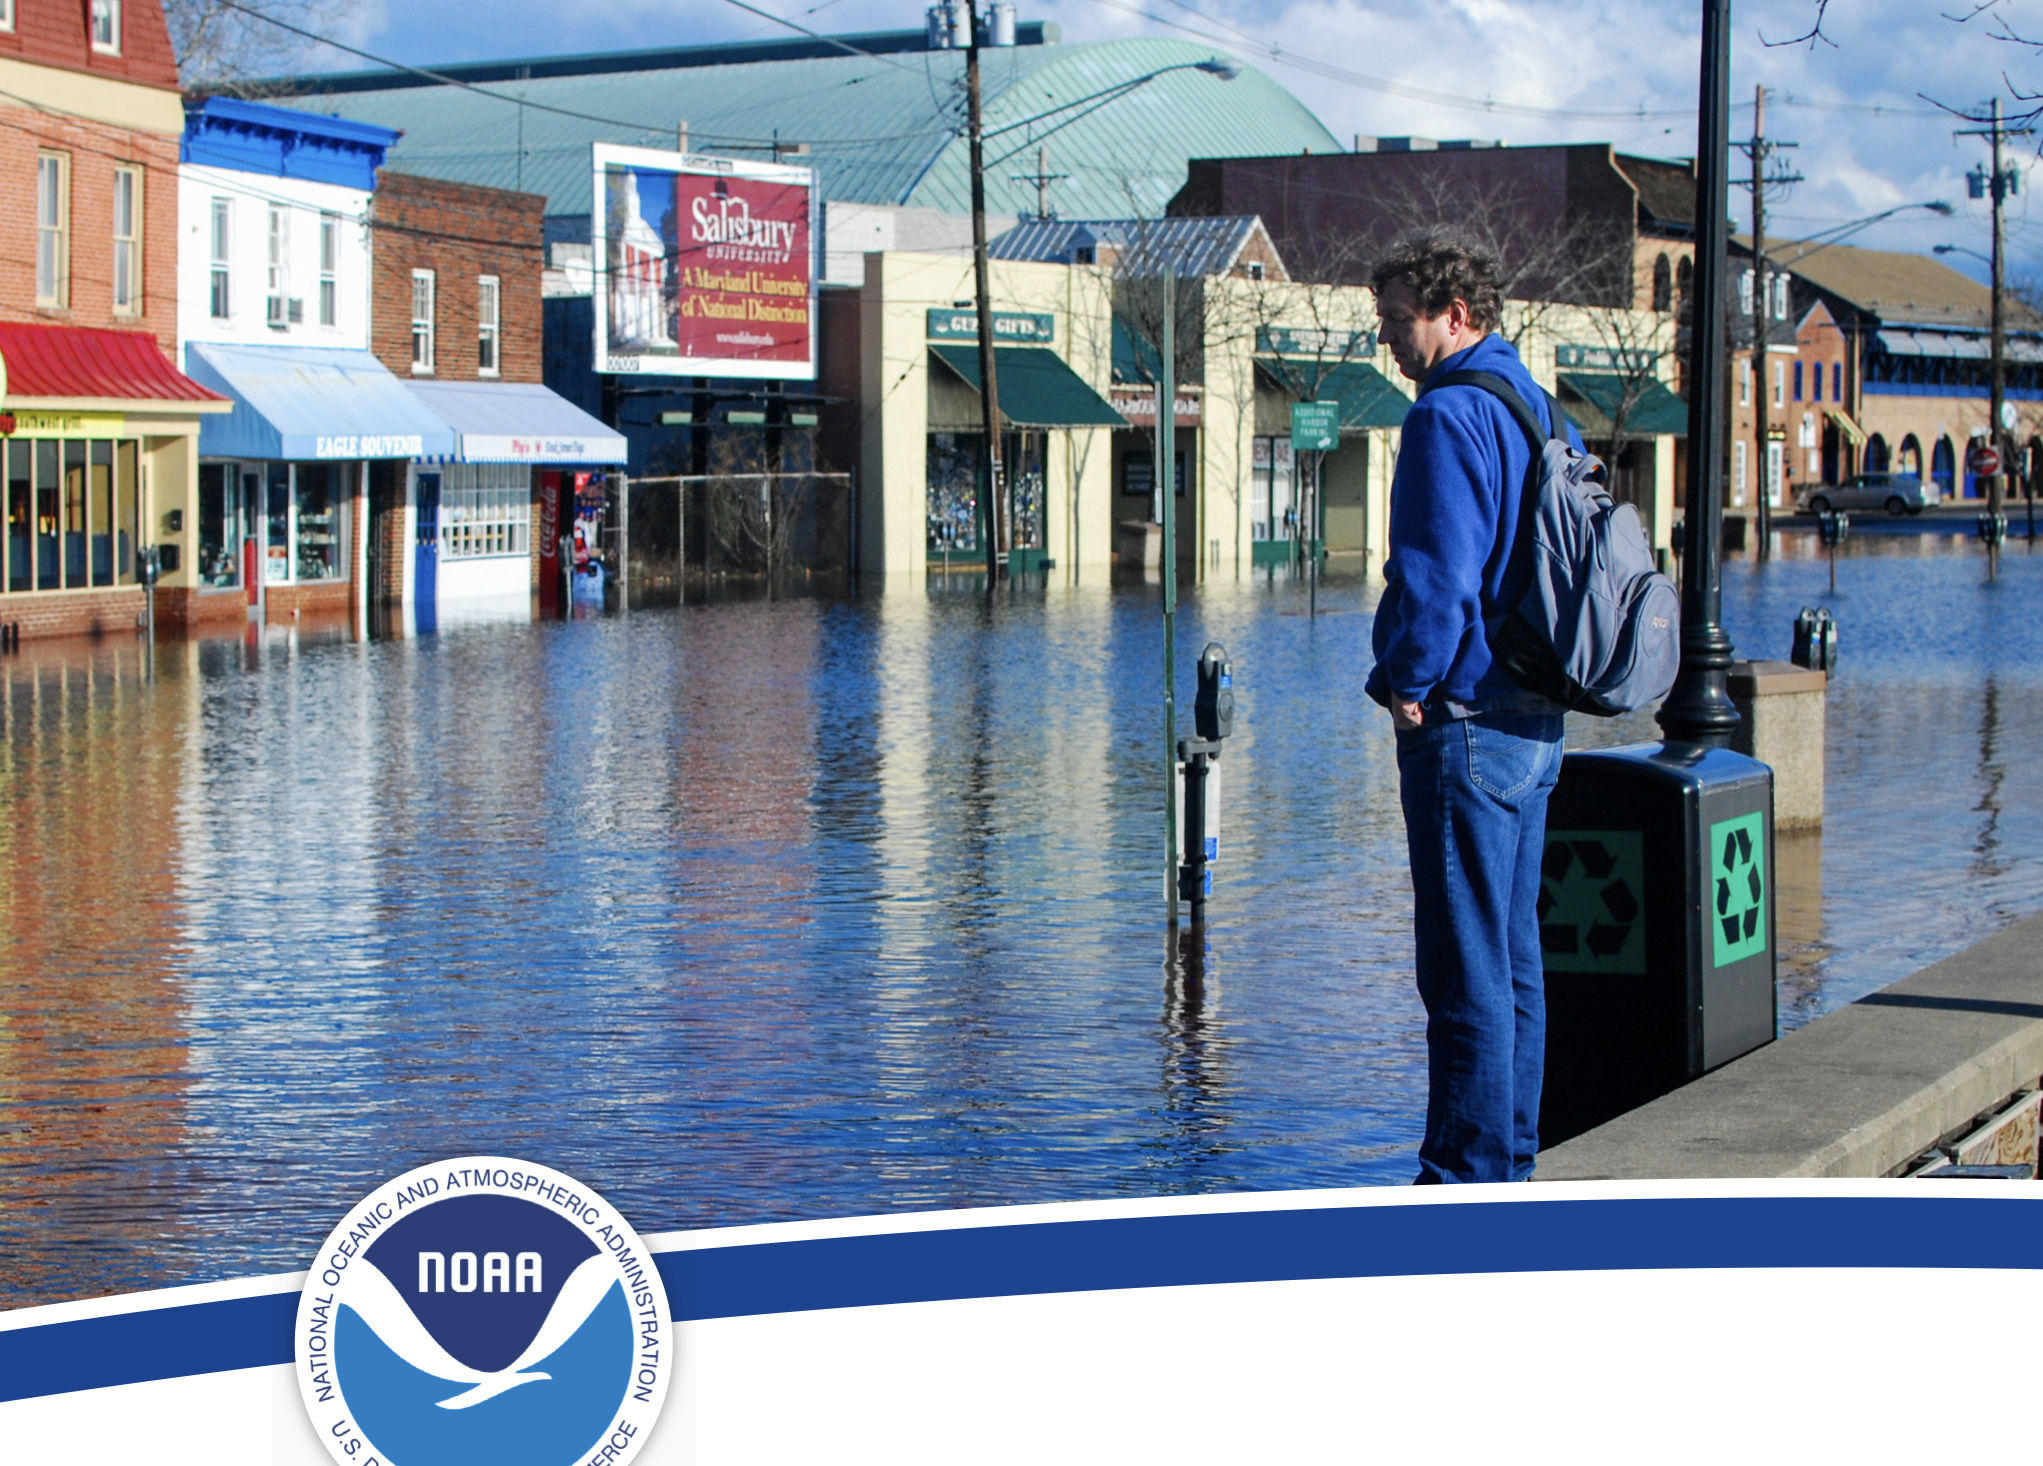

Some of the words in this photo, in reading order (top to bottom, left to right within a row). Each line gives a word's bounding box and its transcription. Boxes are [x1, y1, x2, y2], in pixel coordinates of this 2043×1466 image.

[691, 196, 797, 263] Salisbury
[706, 245, 783, 264] UNIVERSITY
[682, 267, 693, 286] A
[695, 267, 751, 300] Maryland
[752, 271, 808, 300] University
[681, 294, 697, 317] of
[698, 295, 746, 320] National
[748, 298, 807, 323] Distinction
[995, 318, 1035, 334] GIFTS
[1295, 408, 1334, 418] ADDITIONAL
[1301, 418, 1328, 427] HARBOR
[1300, 428, 1328, 437] PARKING
[316, 436, 358, 458] EAGLE
[360, 434, 422, 457] SOUVENIR
